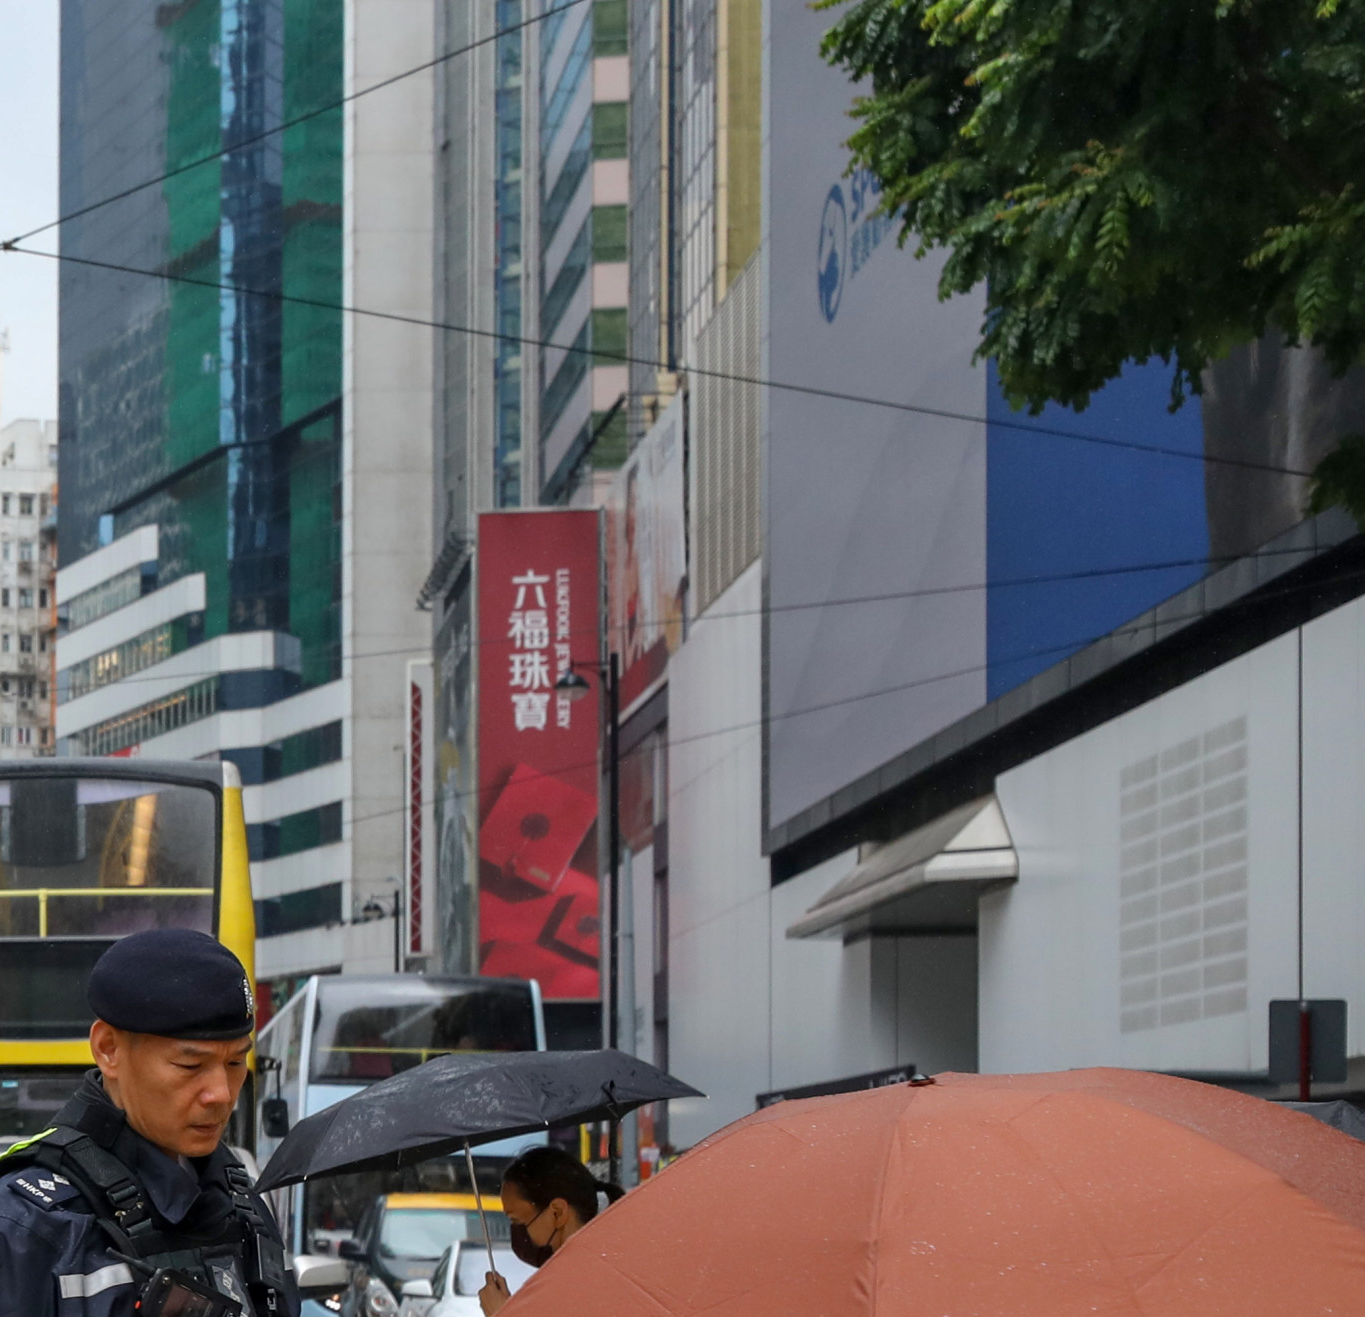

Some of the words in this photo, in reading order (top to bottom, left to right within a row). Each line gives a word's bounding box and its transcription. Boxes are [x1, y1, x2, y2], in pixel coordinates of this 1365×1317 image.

[556, 568, 570, 641] LUKFOOK
[507, 569, 551, 731] 六福珠寶
[554, 643, 570, 729] JEWERY
